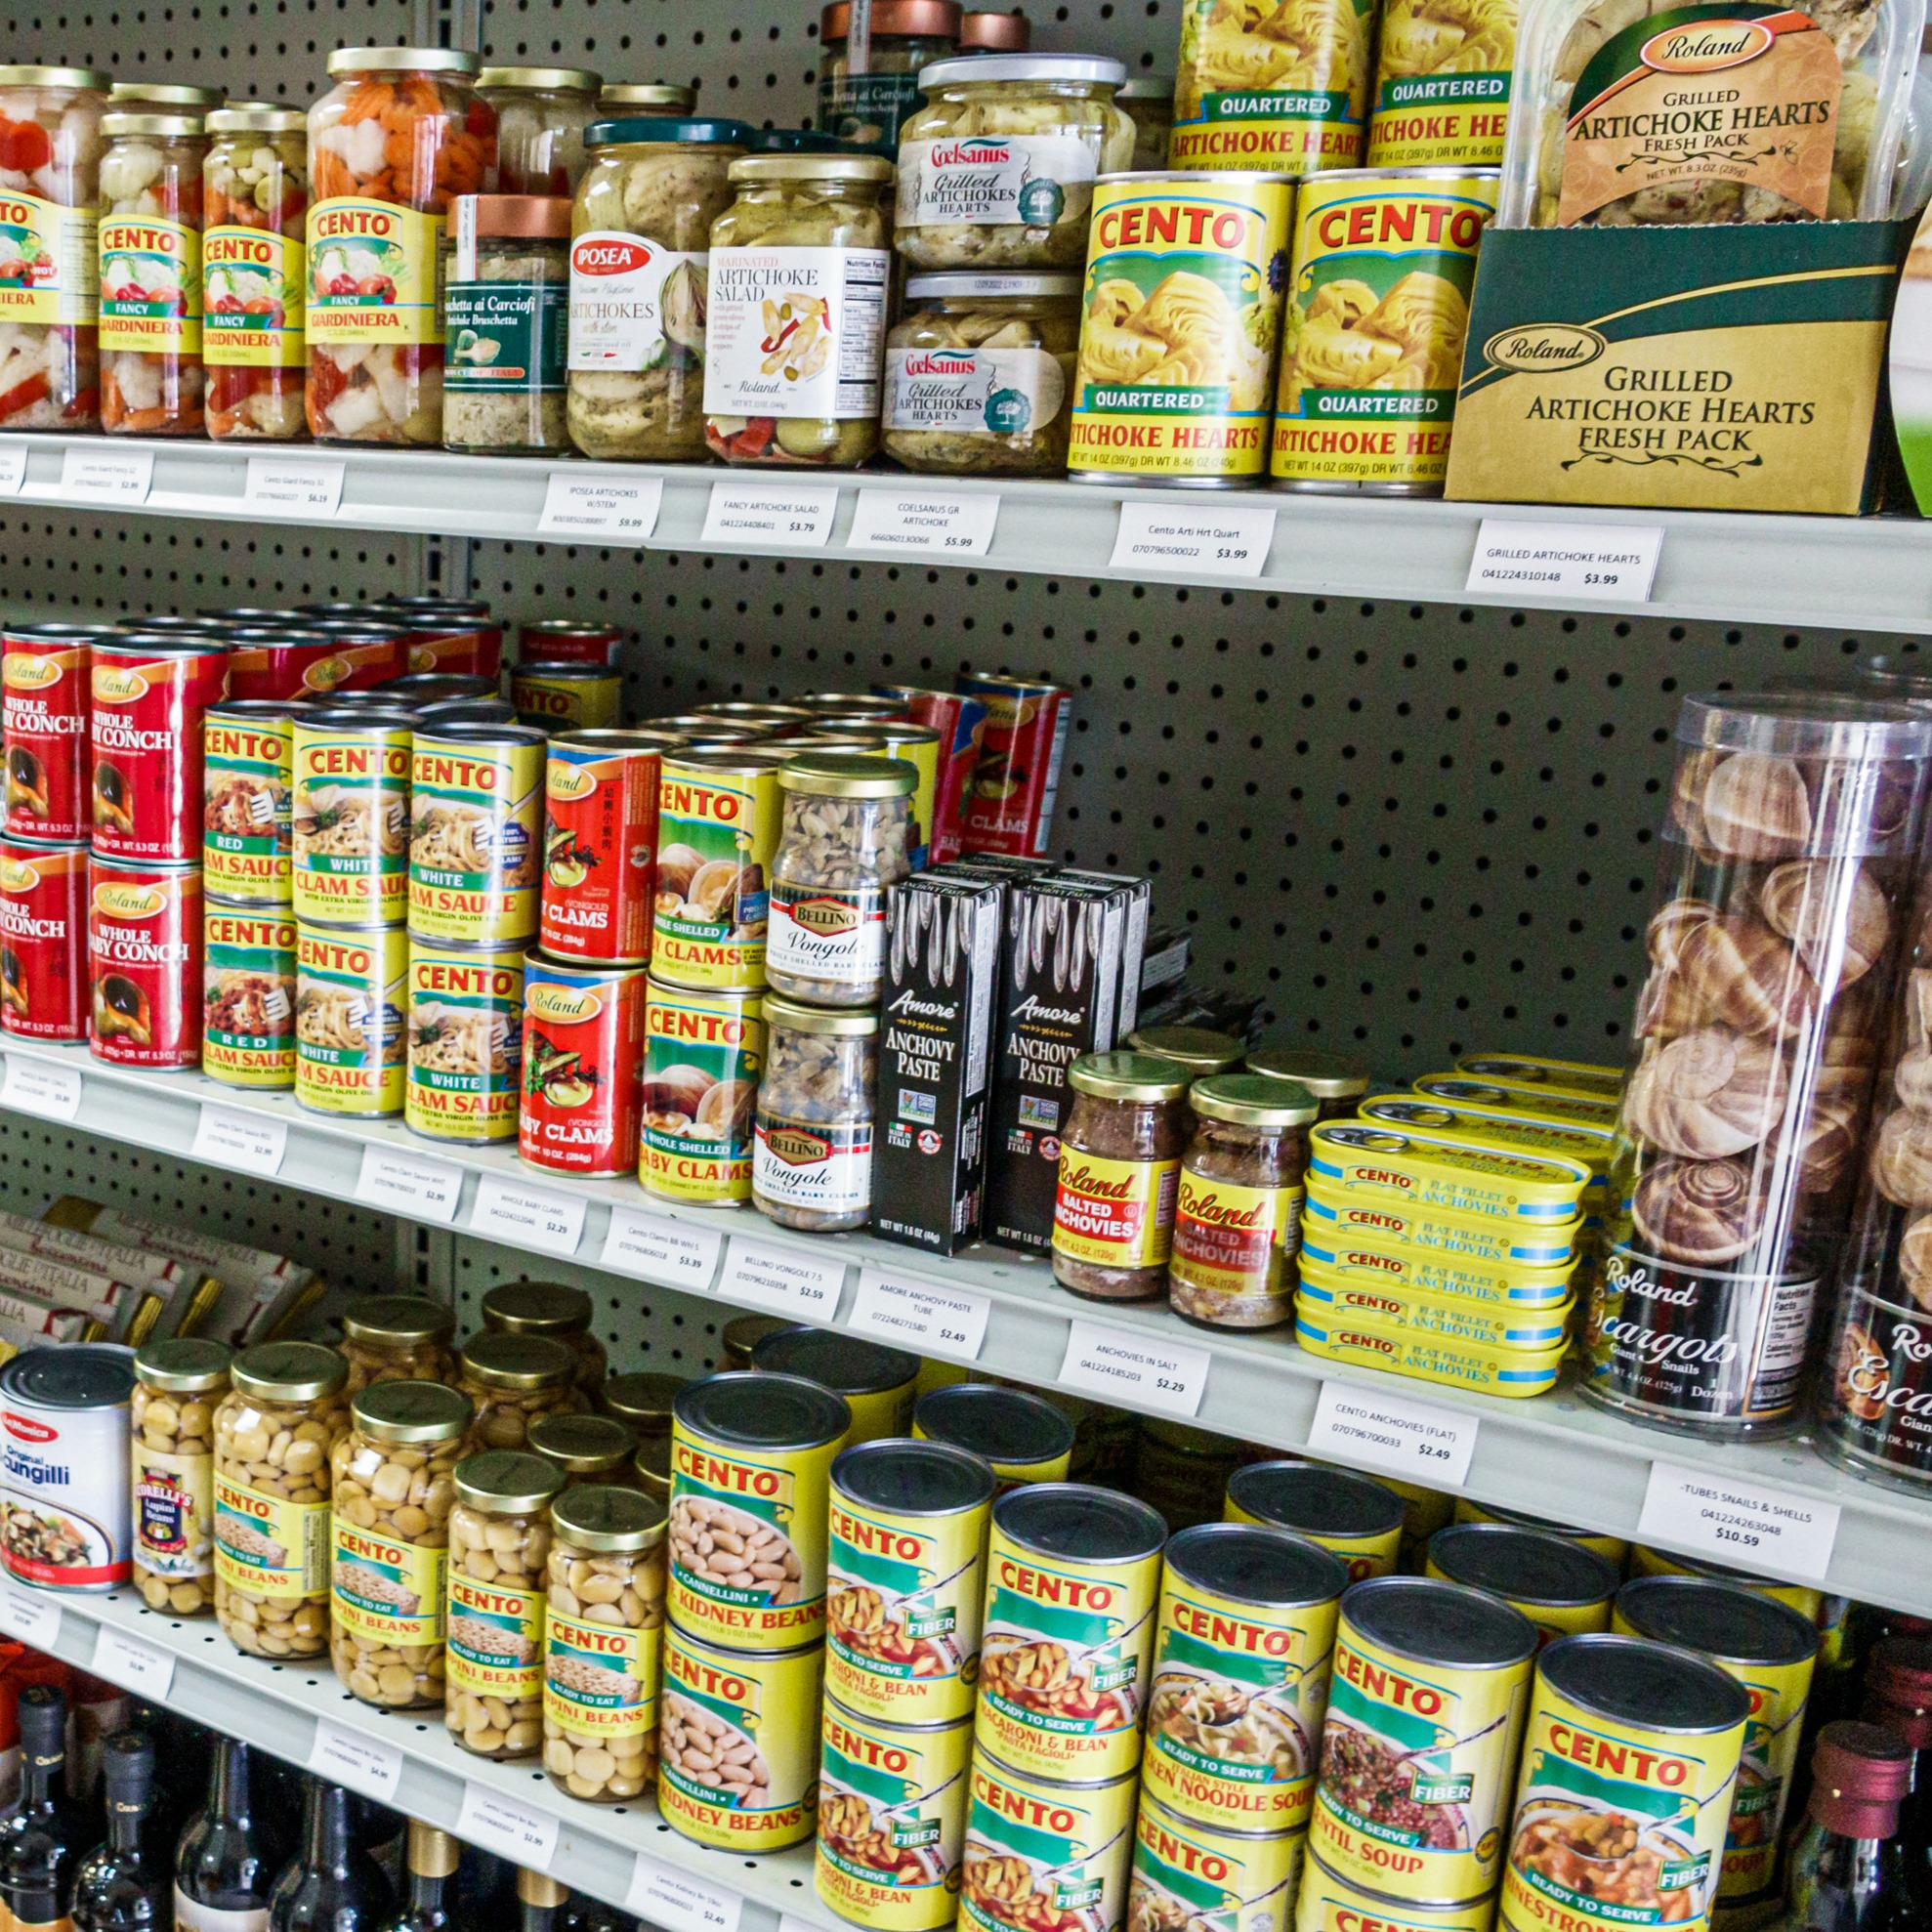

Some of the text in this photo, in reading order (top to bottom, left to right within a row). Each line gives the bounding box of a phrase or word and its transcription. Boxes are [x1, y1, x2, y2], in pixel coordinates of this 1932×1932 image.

[1662, 32, 1751, 59] Roland
[1393, 80, 1503, 101] QUARTERED
[1221, 99, 1330, 114] QUARTERED
[1574, 101, 1829, 141] ARTICHOKE HEARTS
[1174, 131, 1293, 156] ARTICHOKE
[932, 145, 1009, 167] Coelsanus
[935, 174, 998, 189] Grilled
[922, 189, 1016, 203] ARTICHOKES
[940, 203, 990, 213] HEARTS
[316, 212, 391, 236] CENTO
[1099, 206, 1245, 249] CENTO
[1320, 204, 1482, 249] CENTO
[103, 229, 176, 252] CENTO
[206, 239, 273, 263] CENTO
[577, 249, 632, 266] IPOSEA
[33, 267, 55, 276] HOT
[717, 256, 777, 267] MARINATED
[715, 270, 819, 285] ARTICHOKE
[475, 296, 535, 312] ai Carciofi
[715, 286, 765, 302] SALAD
[115, 303, 148, 315] FANCY
[214, 315, 245, 327] FANCY
[312, 313, 399, 327] GIARDINIERA
[472, 314, 518, 325] Bruschetta
[1506, 338, 1578, 360] Roland
[905, 354, 975, 376] Coelsanus
[738, 381, 780, 394] Roland
[1605, 366, 1732, 393] GRILLED
[908, 383, 964, 399] Grilled
[1096, 393, 1204, 408] QUARTERED
[899, 399, 982, 411] ARTICHOKES
[1319, 398, 1438, 413] QUARTERED
[1526, 397, 1816, 425] ARTICHOKE HEARTS
[1173, 427, 1258, 449] HEARTS
[1578, 428, 1752, 451] FRESH PACK
[595, 488, 638, 498] ARTICHOKES
[724, 500, 819, 514] FANCY ARTICHOKE SALAD
[898, 503, 959, 515] COELSANUS GR
[618, 518, 642, 527] $9.99
[789, 523, 815, 532] $3.79
[903, 517, 949, 526] ARTICHOKE
[945, 537, 972, 547] $5.99
[1148, 525, 1239, 540] Cento Arti Hrt Quart
[1132, 544, 1247, 560] 070796500022 $3.99
[1487, 548, 1641, 566] GRILLED ARTICHOKE HEARTS
[1482, 569, 1618, 586] 041224310148 $3.99
[16, 714, 86, 734] CONCH
[101, 731, 173, 750] CONCH
[310, 749, 407, 775] CENTO
[330, 858, 381, 872] WHITE
[296, 871, 349, 896] CLAM
[420, 869, 464, 887] WHITE
[438, 893, 517, 913] SAUCE
[549, 903, 608, 928] CLAMS
[797, 905, 857, 927] BELLINO
[99, 924, 150, 944] WHOLE
[673, 922, 720, 938] SHELLED
[115, 940, 189, 962] CONCH
[787, 932, 865, 961] Vongole
[417, 965, 513, 994] CENTO
[532, 990, 586, 1015] Roland
[650, 1007, 746, 1044] CENTO
[223, 1033, 268, 1048] RED
[885, 1027, 956, 1062] ANCHOVY
[897, 1051, 941, 1082] PASTE
[1019, 1058, 1065, 1087] PASTE
[316, 1070, 391, 1088] SAUCE
[431, 1072, 481, 1090] WHITE
[545, 1123, 613, 1145] CLAMS
[770, 1129, 824, 1157] BELLINO
[679, 1141, 731, 1155] SHELLED
[763, 1157, 833, 1188] Vongole
[1059, 1155, 1136, 1198] Roland
[1356, 1167, 1412, 1189] CENTO
[524, 1199, 541, 1210] BABY
[1421, 1191, 1509, 1218] ANCHOVIES
[1460, 1187, 1503, 1202] FILLET
[1063, 1193, 1112, 1218] SALTED
[1177, 1183, 1266, 1227] Roland
[546, 1221, 567, 1235] $2.29
[1348, 1210, 1405, 1232] CENTO
[650, 1231, 669, 1241] Clams
[1414, 1234, 1502, 1260] ANCHOVIES
[680, 1255, 702, 1269] $3.39
[744, 1255, 809, 1278] BELLINO VONGOLE
[1347, 1252, 1404, 1274] CENTO
[1412, 1275, 1500, 1302] ANCHOVIES
[1606, 1257, 1695, 1307] Roland
[800, 1286, 823, 1300] $2.59
[879, 1282, 972, 1314] AMORE ANCHOVY PASTE
[913, 1304, 933, 1316] TUBE
[1345, 1292, 1402, 1315] CENTO
[940, 1328, 966, 1342] $2.49
[1338, 1331, 1395, 1354] CENTO
[1096, 1344, 1179, 1372] ANCHOVIES IN SALT
[1661, 1360, 1700, 1375] Snails
[1156, 1377, 1186, 1394] $2.29
[1691, 1385, 1733, 1400] Dozen
[1335, 1402, 1457, 1443] CENTO ANCHOVIES (FLAT)
[1331, 1421, 1450, 1461] 070796700033 $2.49
[7, 1444, 44, 1465] Original
[146, 1497, 176, 1515] Lupini
[1721, 1493, 1758, 1510] SNAILS
[1773, 1505, 1812, 1523] SHELLS
[1701, 1508, 1782, 1536] 041224263048
[1715, 1527, 1759, 1547] $10.59
[684, 1574, 749, 1604] CANNELLINI
[680, 1592, 756, 1629] KIDNEY
[365, 1616, 421, 1634] BEANS
[907, 1617, 955, 1636] FIBER
[483, 1669, 539, 1684] BEANS
[1092, 1666, 1137, 1688] FIBER
[885, 1679, 928, 1697] BEAN
[585, 1709, 644, 1724] BEANS
[993, 1696, 1087, 1733] READY SERVE
[1065, 1735, 1109, 1751] BEAN
[1164, 1740, 1265, 1781] READY SERVE
[1179, 1779, 1268, 1812] NOODLE
[1212, 1781, 1246, 1793] STYLE
[1414, 1784, 1471, 1800] FIBER
[729, 1807, 802, 1830] BEANS
[893, 1828, 940, 1846] FIBER
[1364, 1820, 1410, 1844] SERVE
[1361, 1843, 1424, 1874] SOUP
[1530, 1872, 1653, 1922] READY SERVE
[704, 1911, 726, 1925] $2.49
